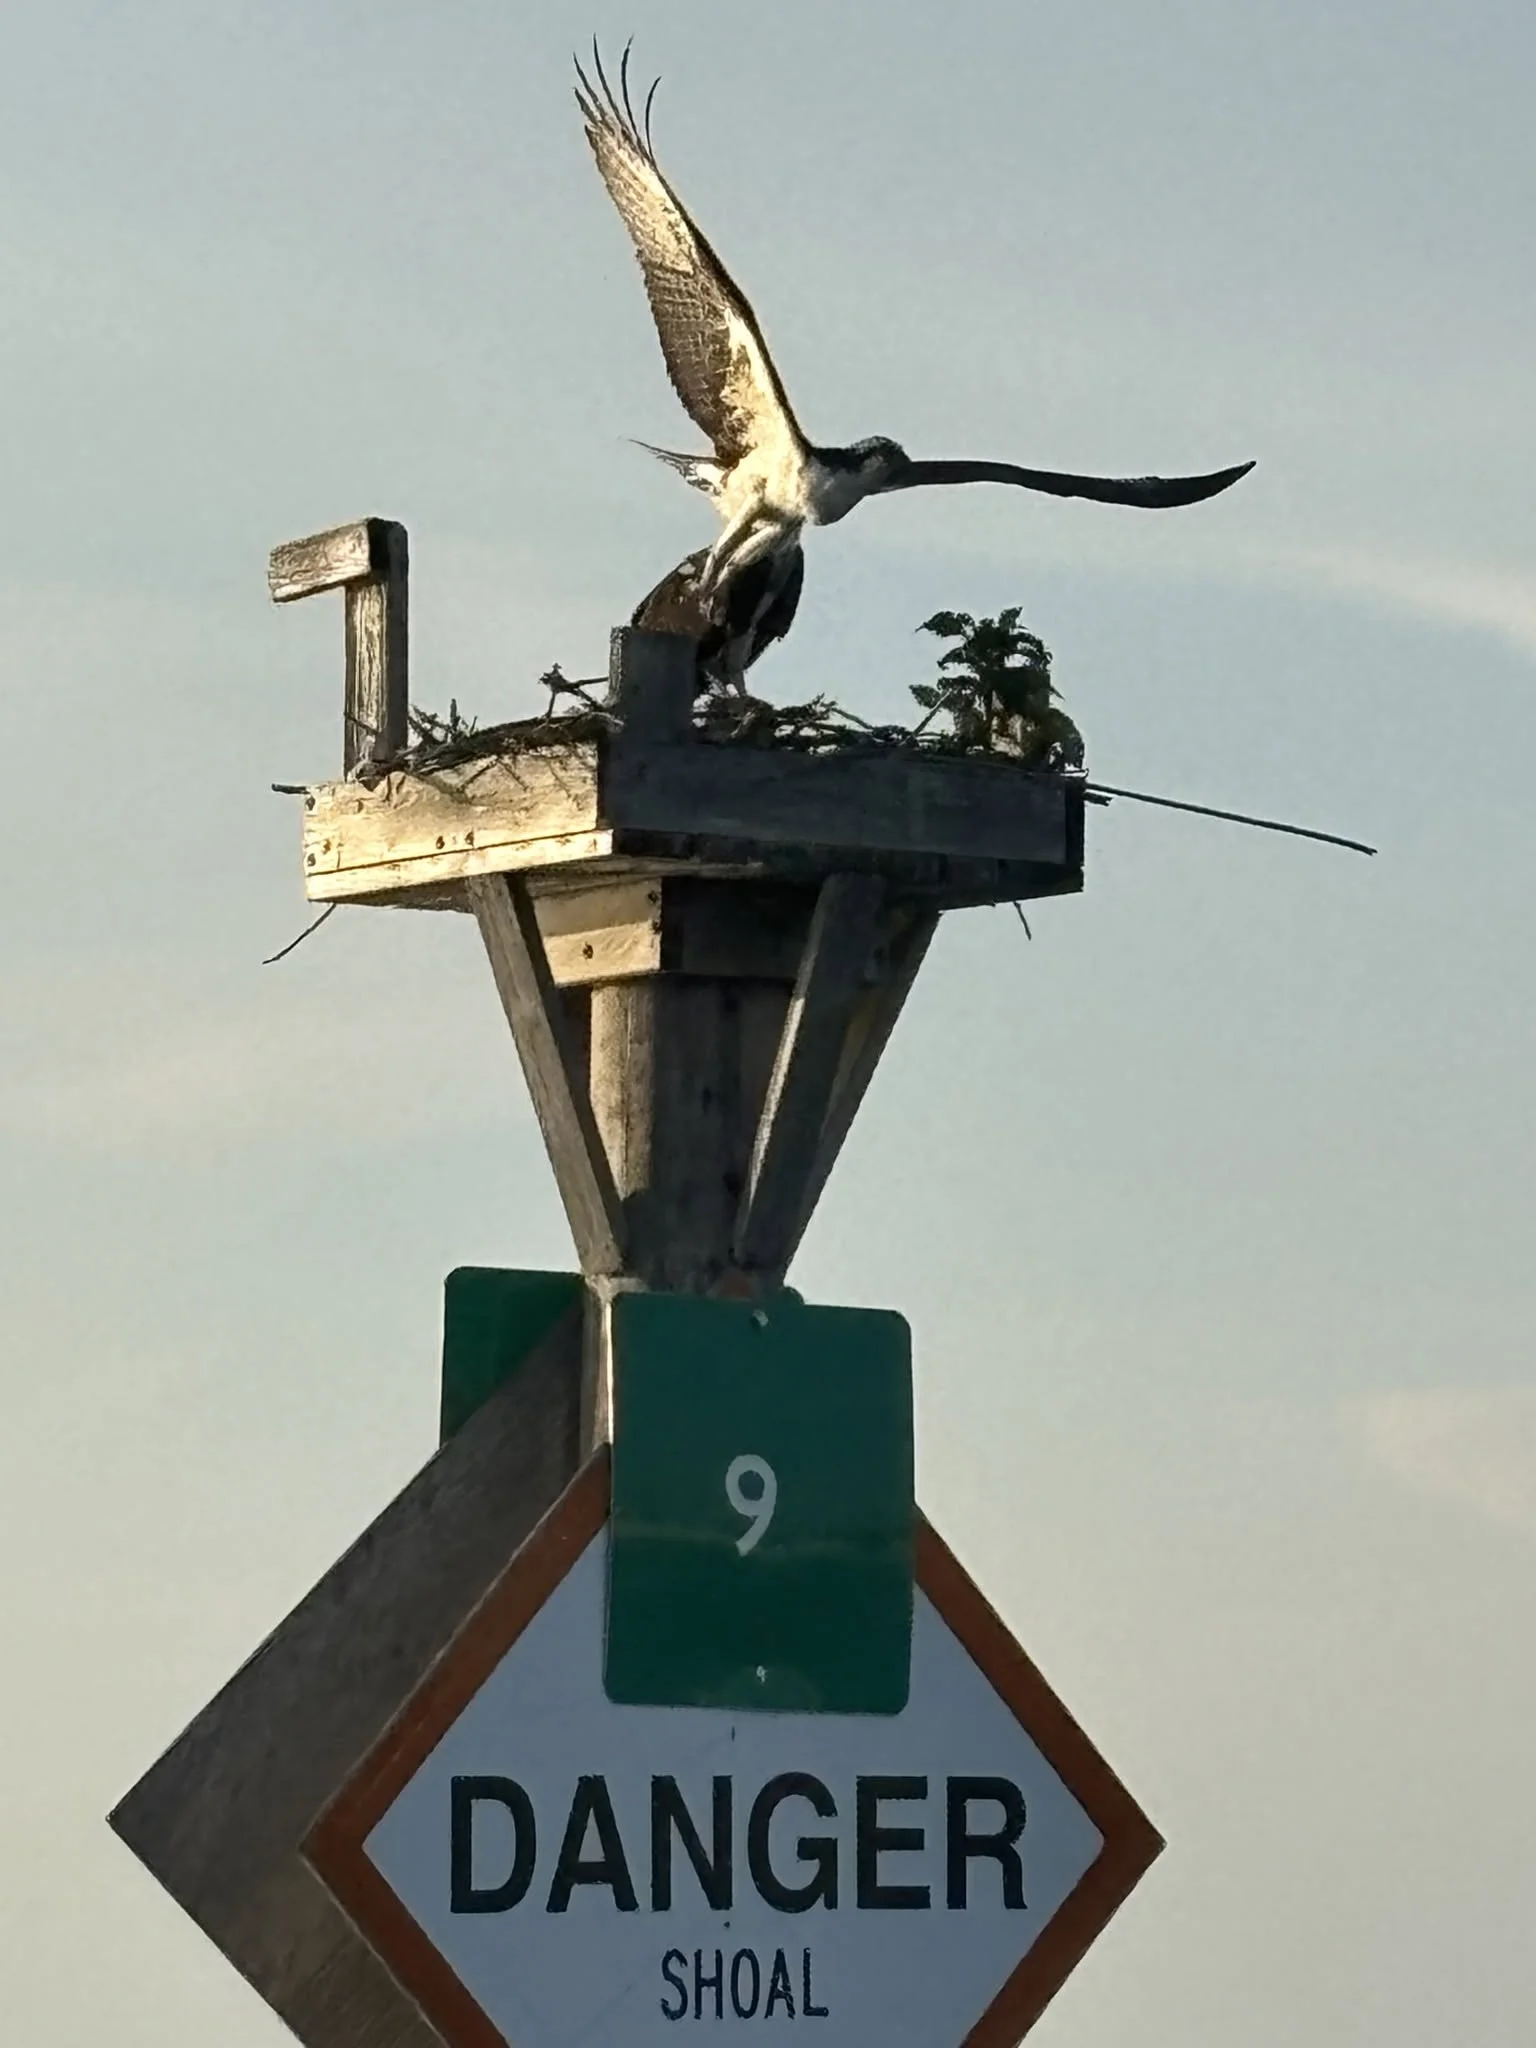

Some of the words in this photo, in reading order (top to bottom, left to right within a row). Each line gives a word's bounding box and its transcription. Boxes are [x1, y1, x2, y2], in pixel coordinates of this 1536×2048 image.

[724, 1453, 778, 1557] 9
[449, 1771, 1028, 1915] DANGER
[659, 1946, 830, 2022] SHOAL
